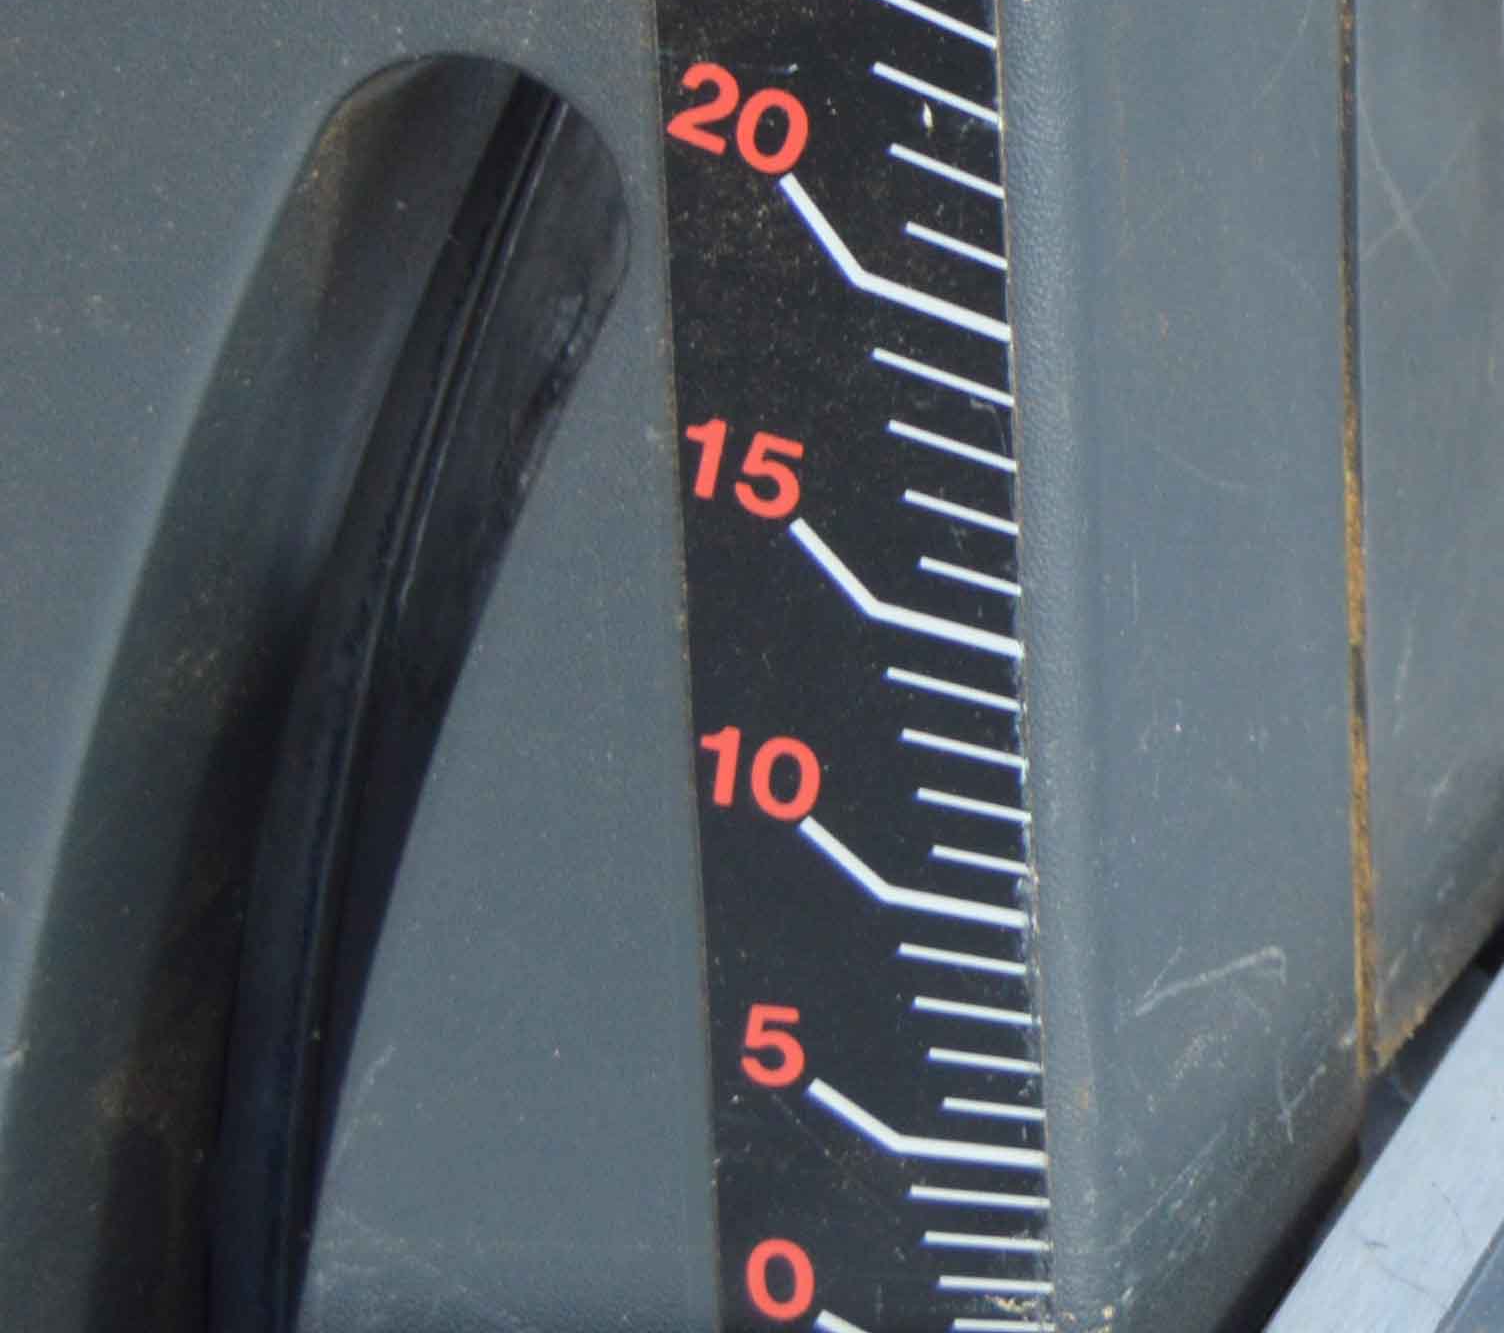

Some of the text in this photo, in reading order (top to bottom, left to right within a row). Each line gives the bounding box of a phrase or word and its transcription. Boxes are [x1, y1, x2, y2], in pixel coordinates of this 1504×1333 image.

[665, 61, 811, 176] 20
[684, 418, 807, 520] 15
[700, 723, 823, 823] 10
[740, 1003, 807, 1089] 5
[744, 1238, 818, 1322] 0
